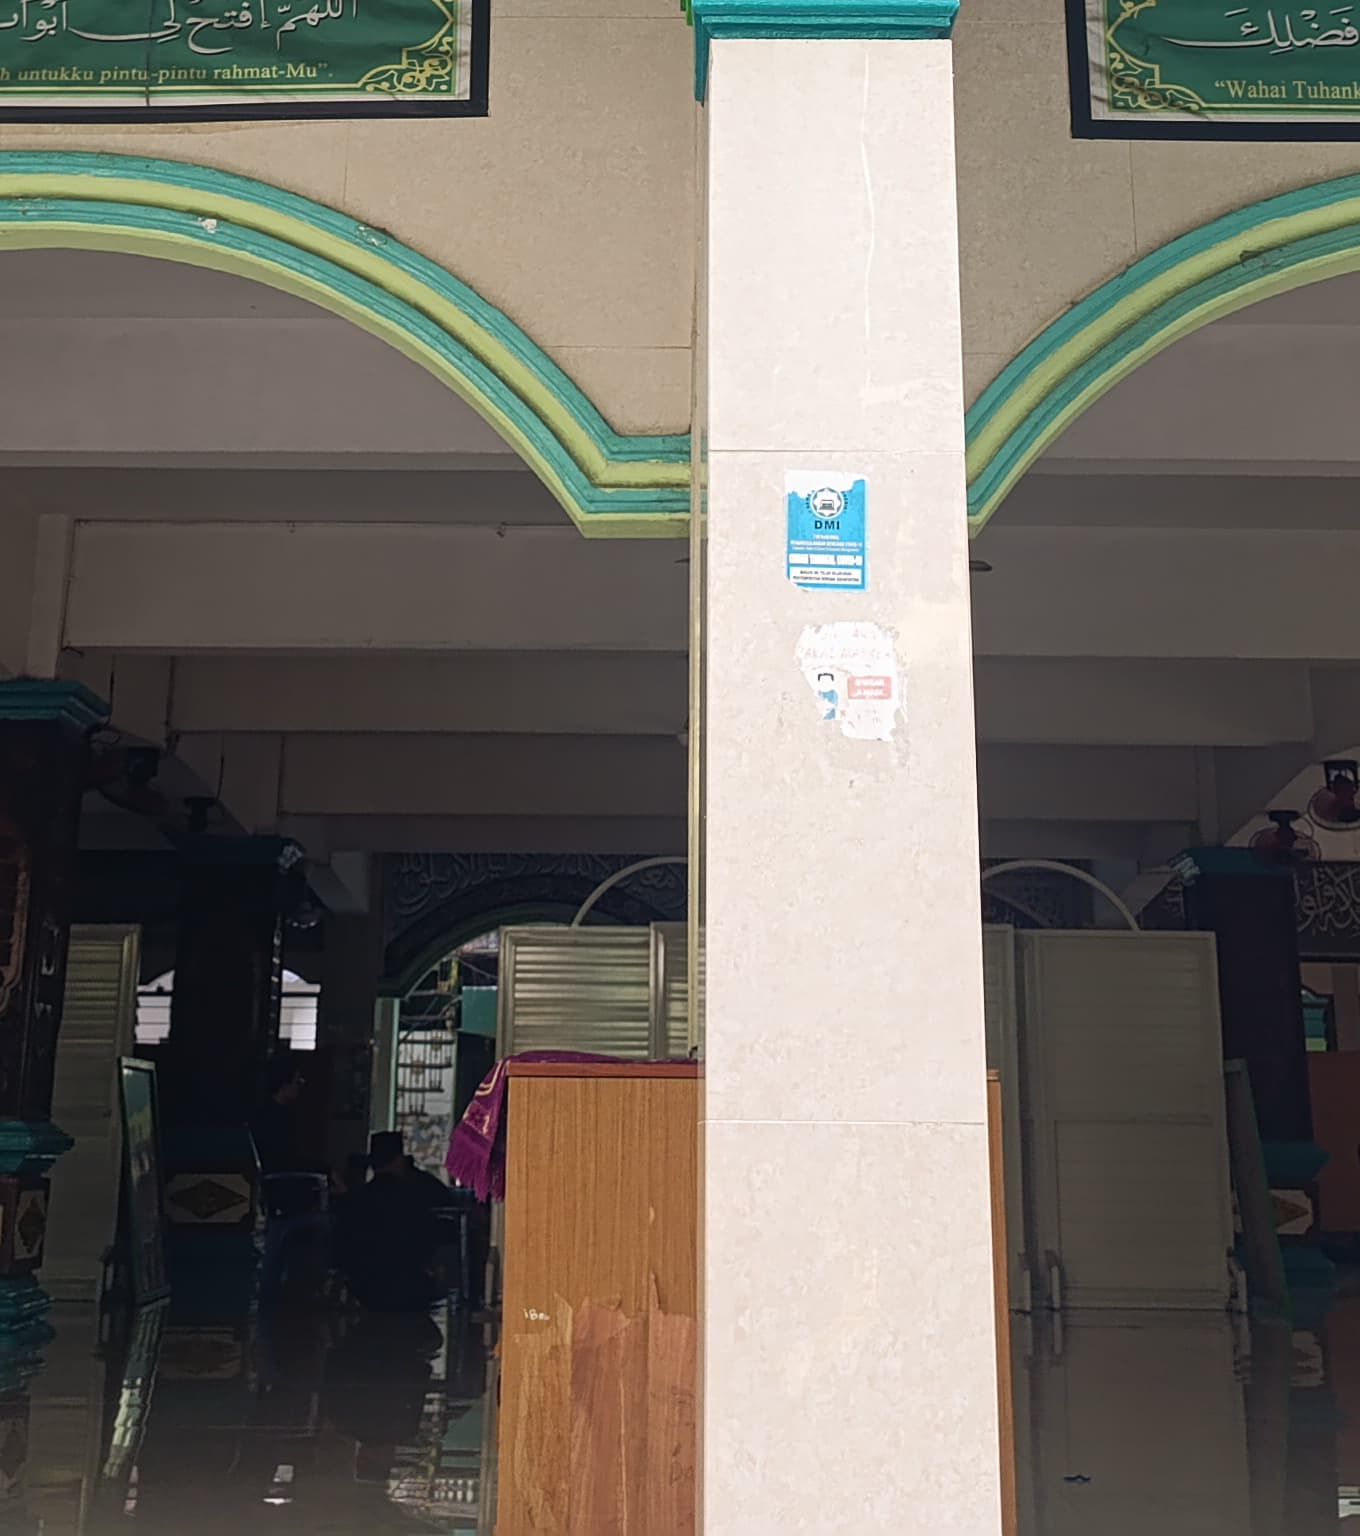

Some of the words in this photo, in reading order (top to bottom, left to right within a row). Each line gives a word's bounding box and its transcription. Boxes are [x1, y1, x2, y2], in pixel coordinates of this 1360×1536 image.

[18, 66, 95, 82] untukku
[99, 66, 208, 83] pintu-pintu
[813, 519, 841, 531] DMI
